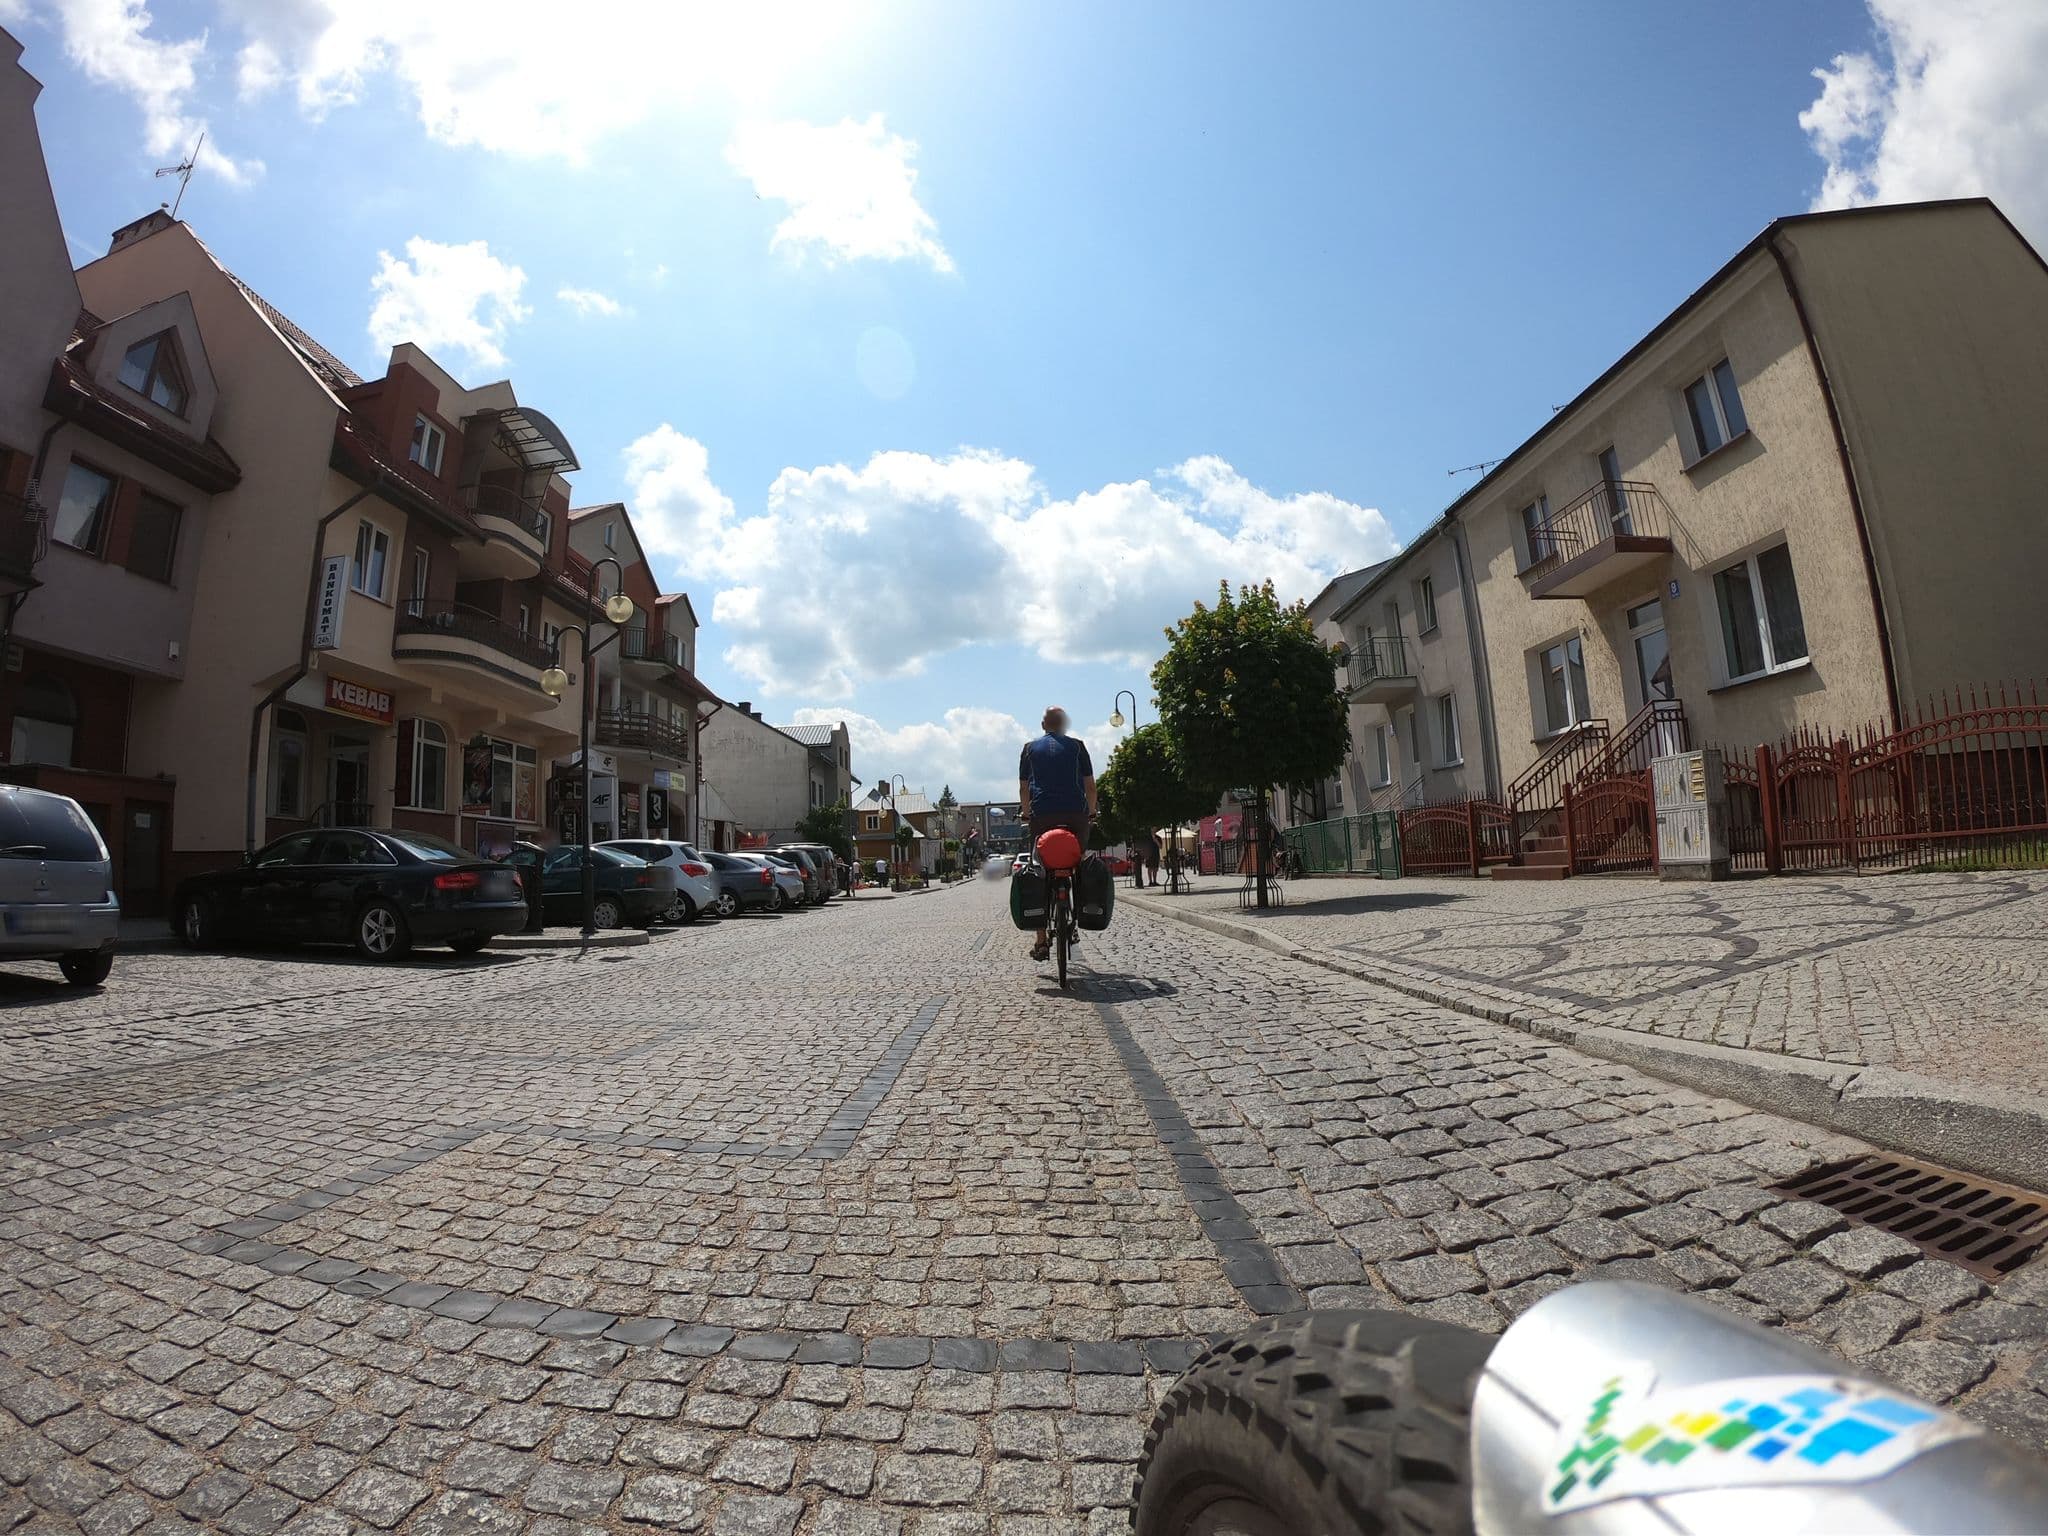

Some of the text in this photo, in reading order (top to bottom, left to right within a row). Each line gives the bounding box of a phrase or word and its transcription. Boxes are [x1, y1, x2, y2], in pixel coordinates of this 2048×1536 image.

[320, 563, 337, 633] BANKOMAT
[331, 679, 390, 712] KEBAB
[592, 793, 611, 805] 4F
